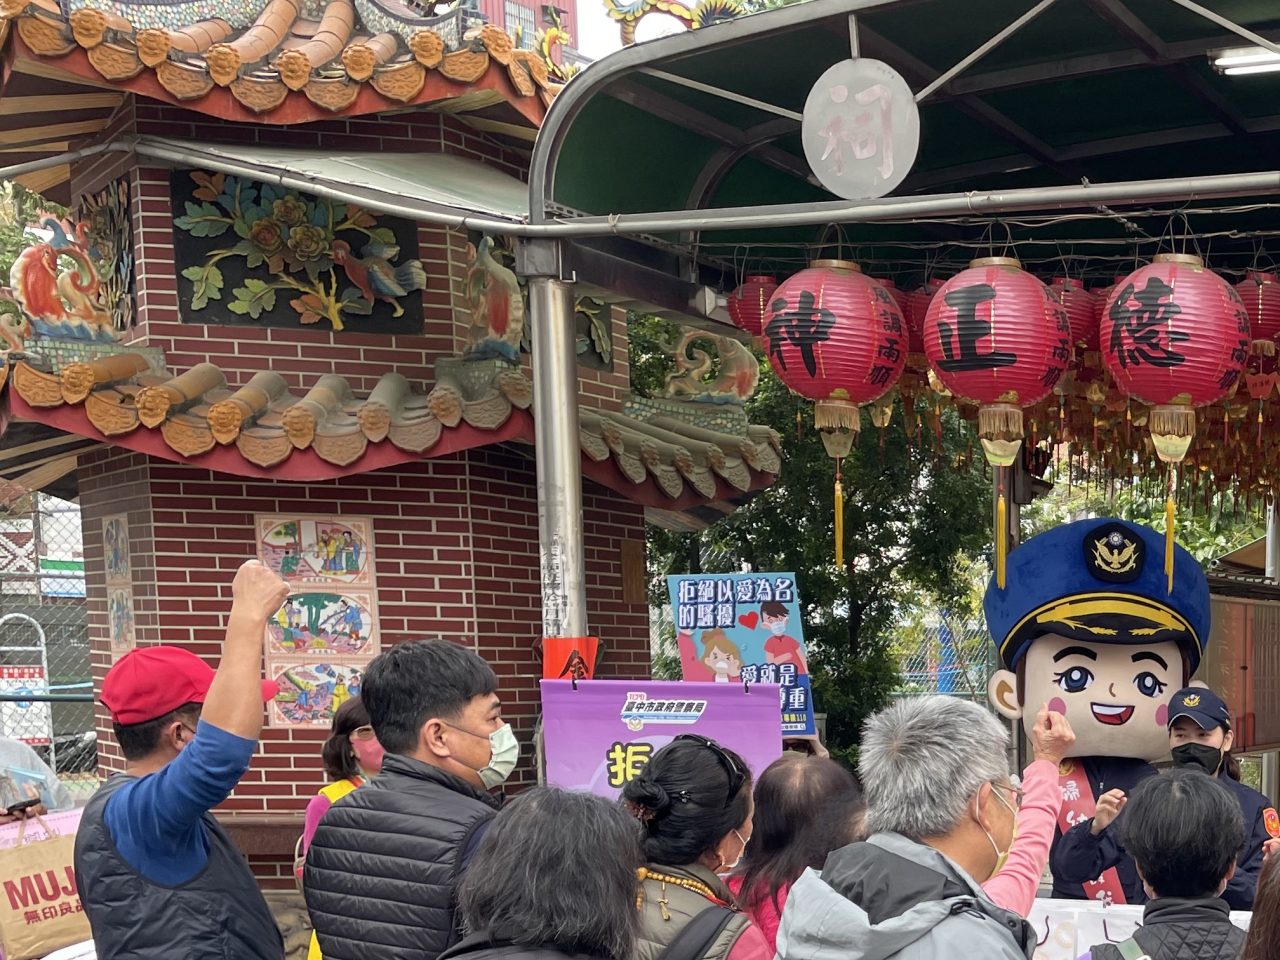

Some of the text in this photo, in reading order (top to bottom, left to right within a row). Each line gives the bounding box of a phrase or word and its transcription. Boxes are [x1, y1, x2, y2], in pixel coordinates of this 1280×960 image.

[818, 84, 893, 179] 祠
[764, 290, 837, 378] 神
[935, 283, 1017, 372] 正
[1108, 277, 1190, 369] 德
[678, 579, 792, 602] 拒絕以愛為名
[679, 603, 734, 627] 的騷擾
[741, 664, 796, 686] 愛就是
[3, 865, 78, 910] MUJ
